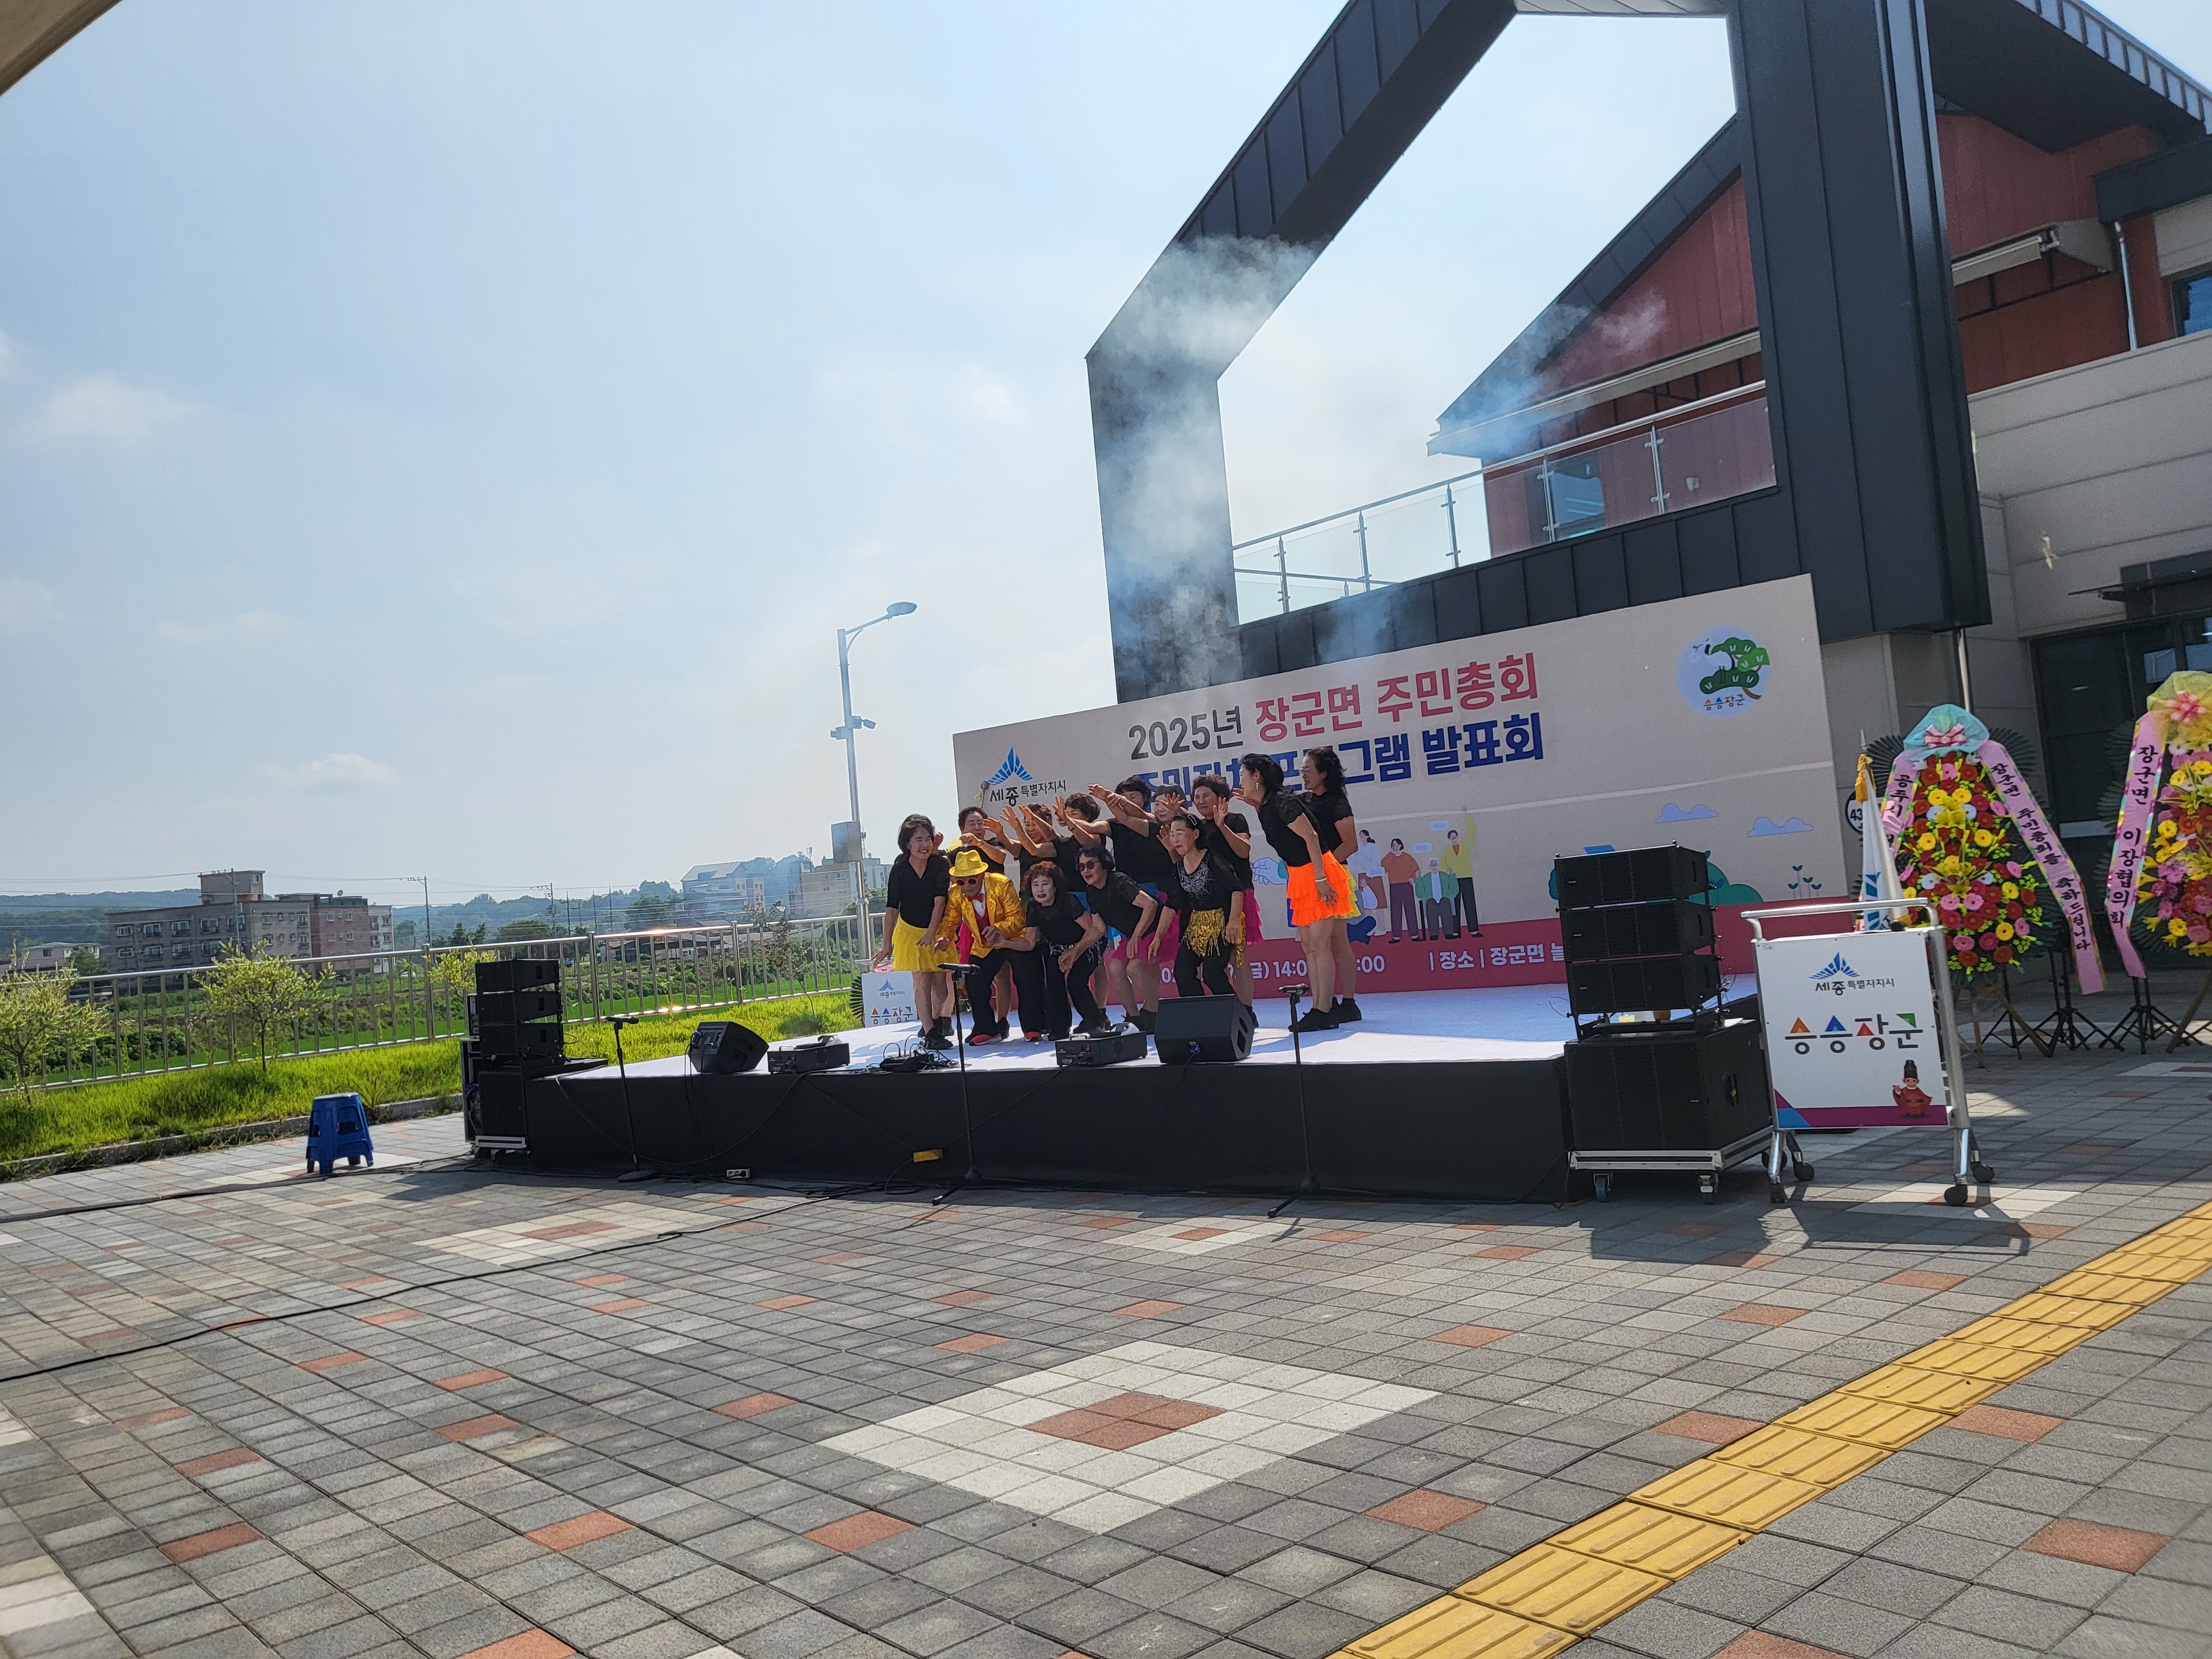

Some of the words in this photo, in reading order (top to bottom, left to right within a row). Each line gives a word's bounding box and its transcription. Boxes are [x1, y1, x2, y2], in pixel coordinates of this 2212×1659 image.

[1129, 705, 1244, 760] 2025년
[1255, 684, 1363, 742] 장군면
[1376, 651, 1538, 723] 주민총회
[1269, 733, 1412, 791] 프그램
[1422, 712, 1544, 776] 발표회
[1273, 959, 1307, 978] 14:0
[1439, 951, 1475, 970] 장소
[1490, 943, 1545, 966] 장군면
[1551, 942, 1565, 962] 늘
